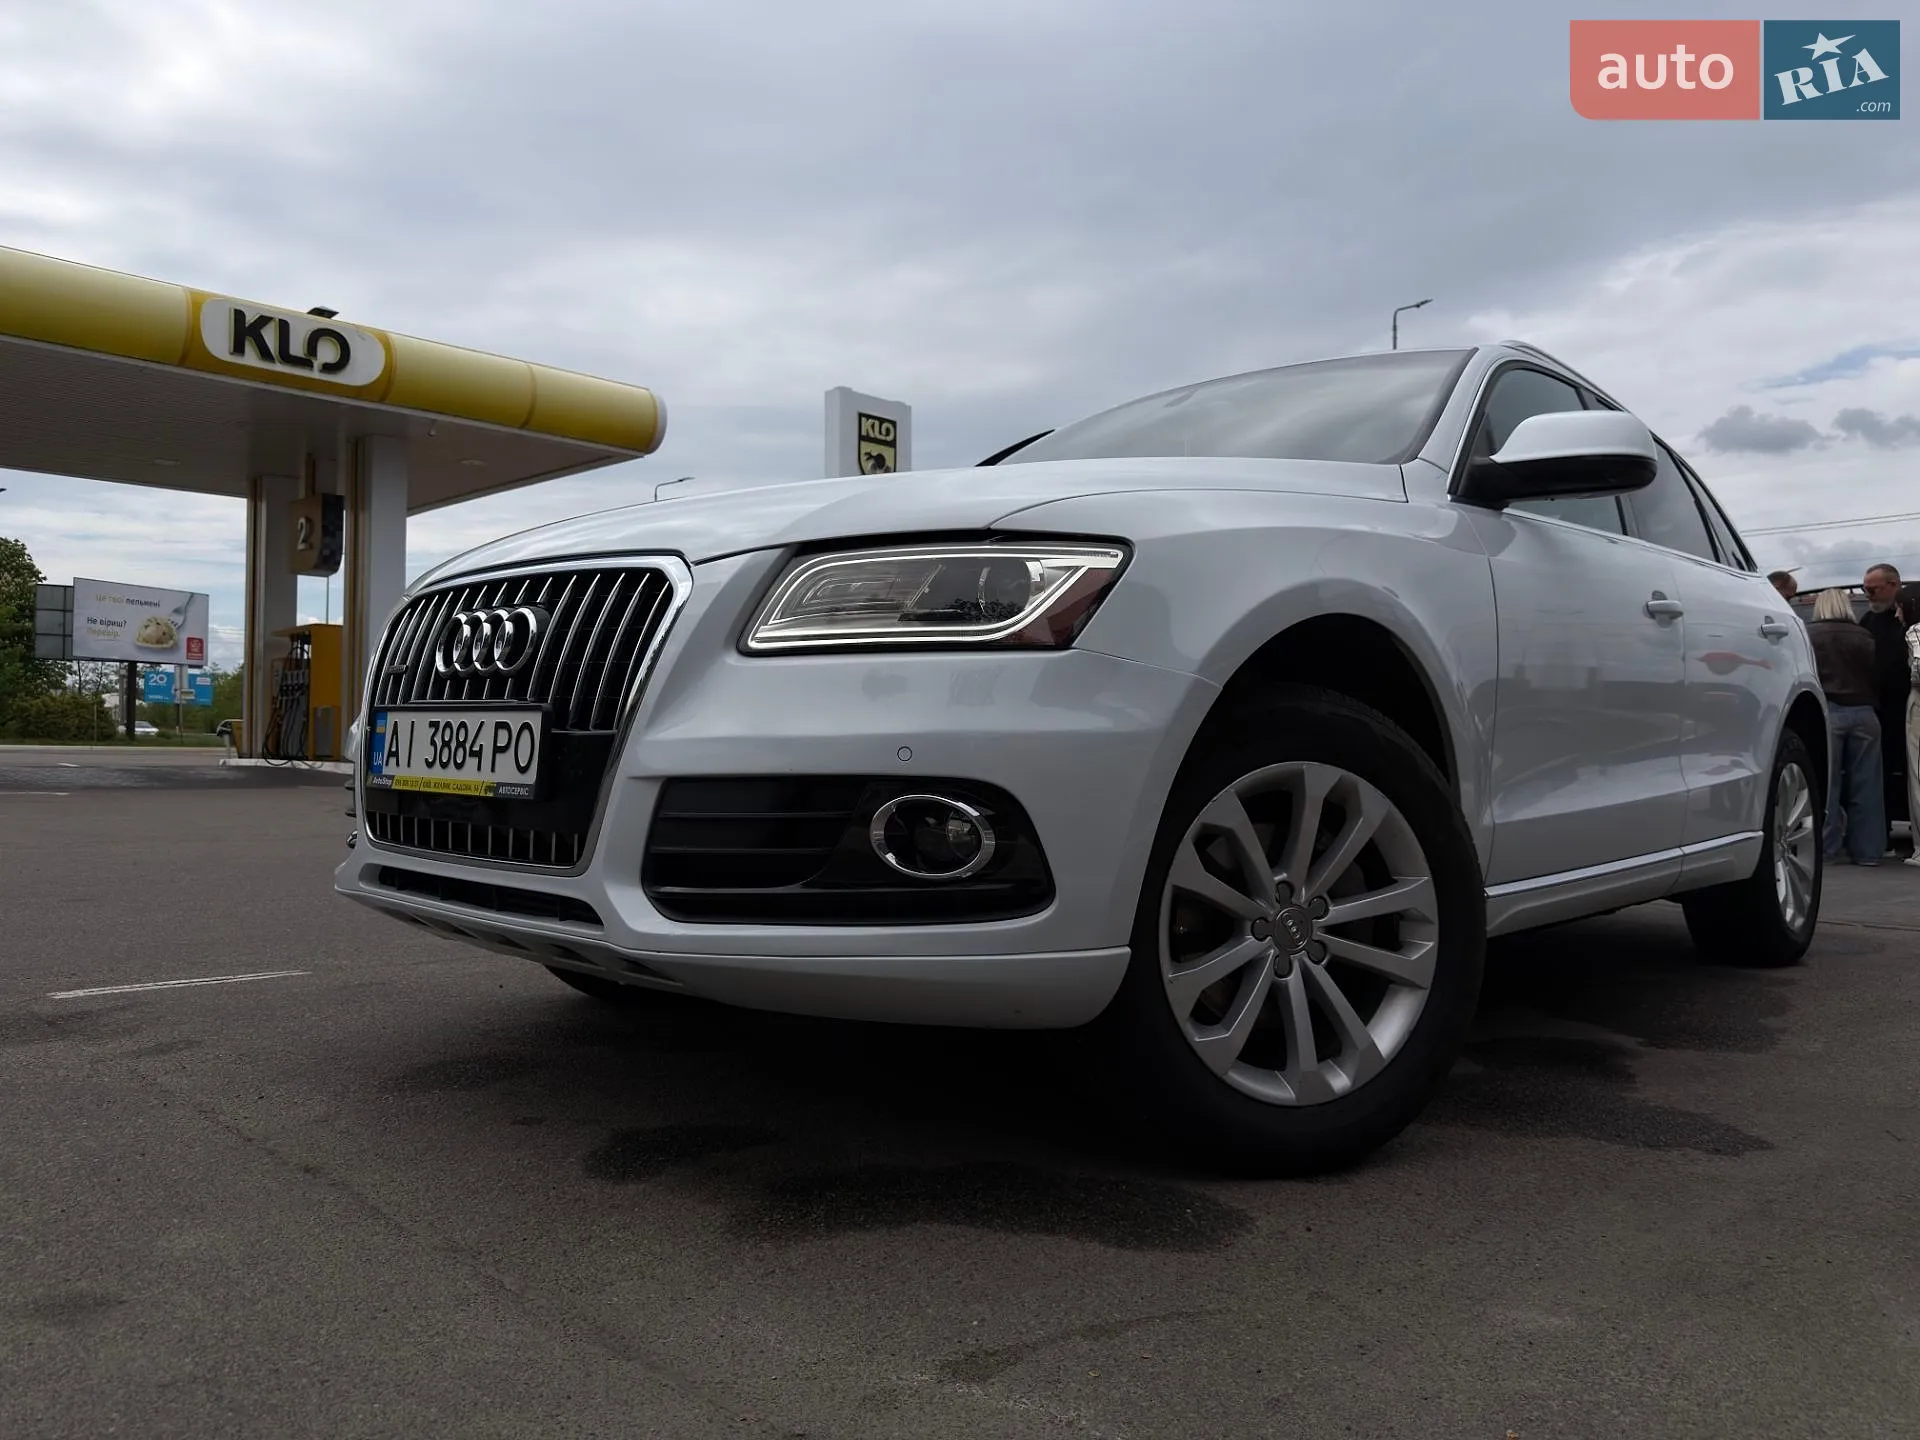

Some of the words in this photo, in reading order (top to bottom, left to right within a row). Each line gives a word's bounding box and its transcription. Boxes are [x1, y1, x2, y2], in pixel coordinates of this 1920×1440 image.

[229, 307, 351, 373] KLO
[861, 417, 895, 442] KLO
[297, 517, 311, 550] 2
[125, 598, 160, 608] пельмені
[87, 616, 98, 625] Не
[99, 617, 127, 630] віриш?
[373, 752, 383, 766] UA
[385, 720, 415, 768] AI
[425, 720, 485, 772] 3884
[491, 720, 535, 774] PO
